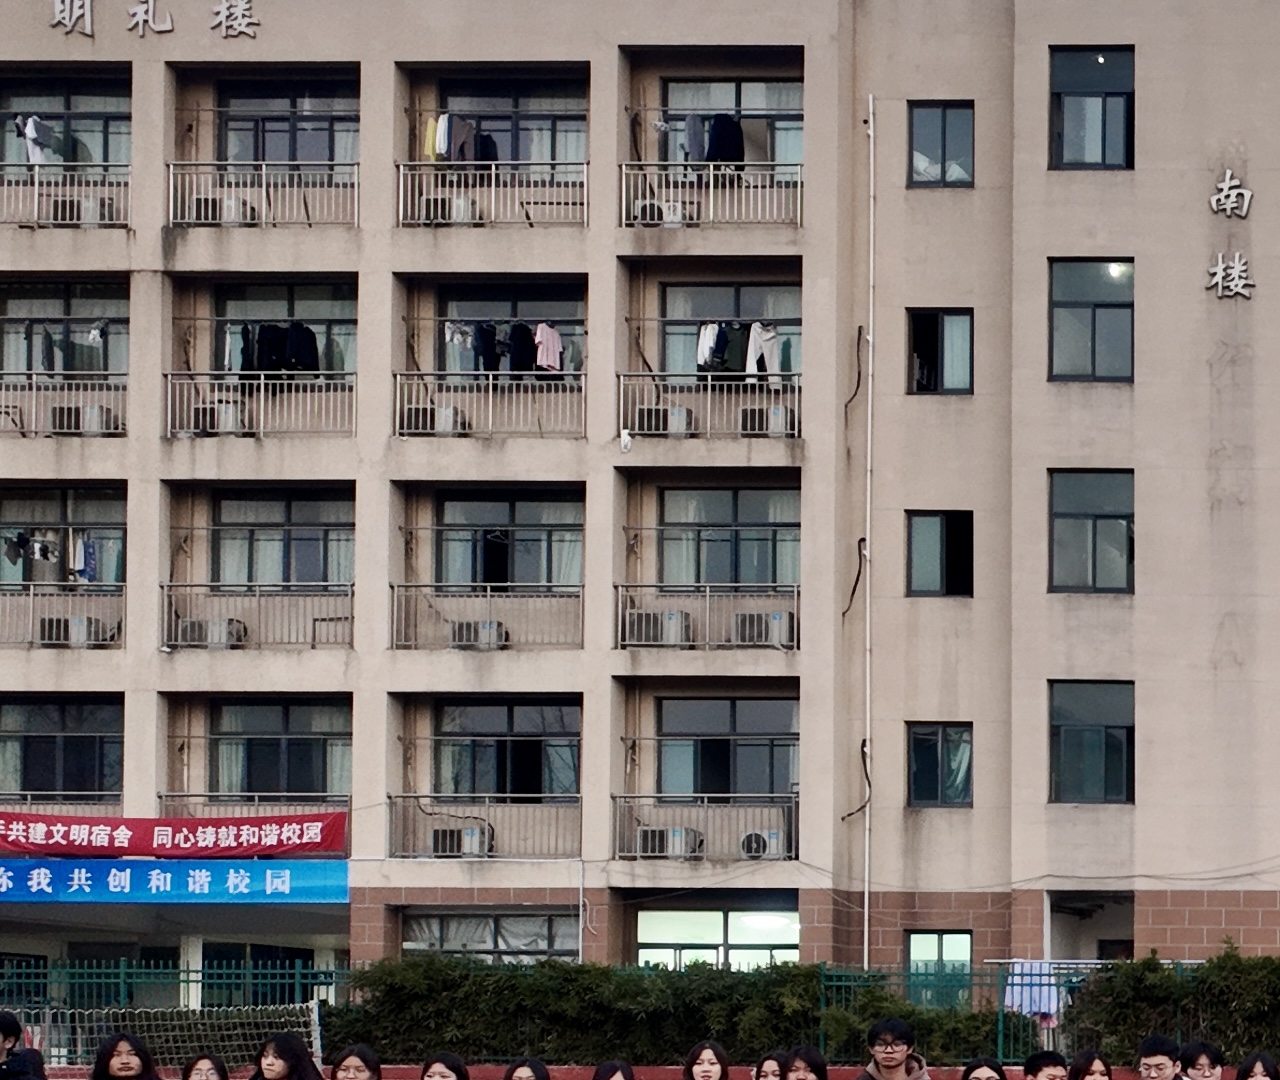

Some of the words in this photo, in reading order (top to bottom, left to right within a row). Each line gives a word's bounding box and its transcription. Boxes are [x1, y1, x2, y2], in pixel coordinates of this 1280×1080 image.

[1205, 169, 1256, 300] 南楼
[152, 822, 323, 848] 同心铸就和谐校园
